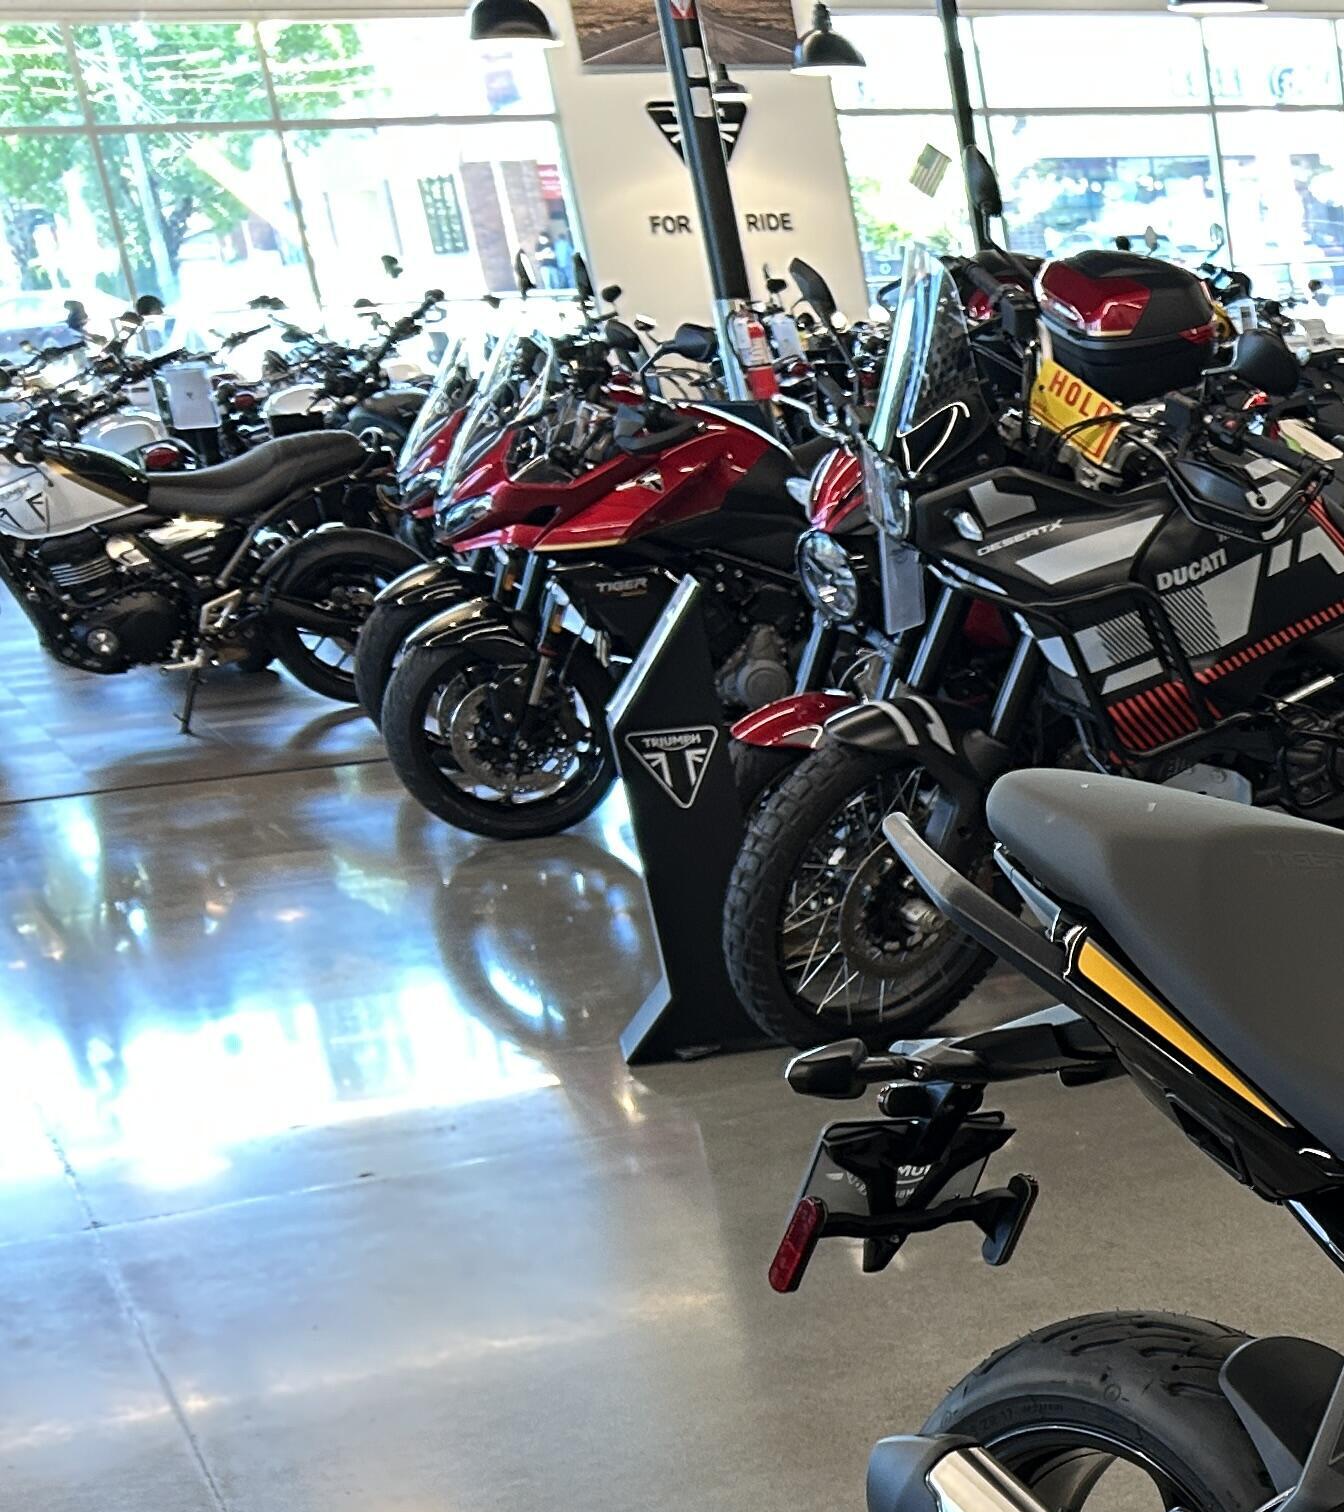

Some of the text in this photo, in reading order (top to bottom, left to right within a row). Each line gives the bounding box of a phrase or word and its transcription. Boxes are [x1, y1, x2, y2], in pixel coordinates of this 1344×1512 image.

[648, 212, 794, 234] FOR RIDE
[976, 518, 1065, 556] DESERTX
[1156, 548, 1228, 591] DUCATI
[596, 577, 649, 593] TIGER
[641, 732, 702, 749] TRIUMPH
